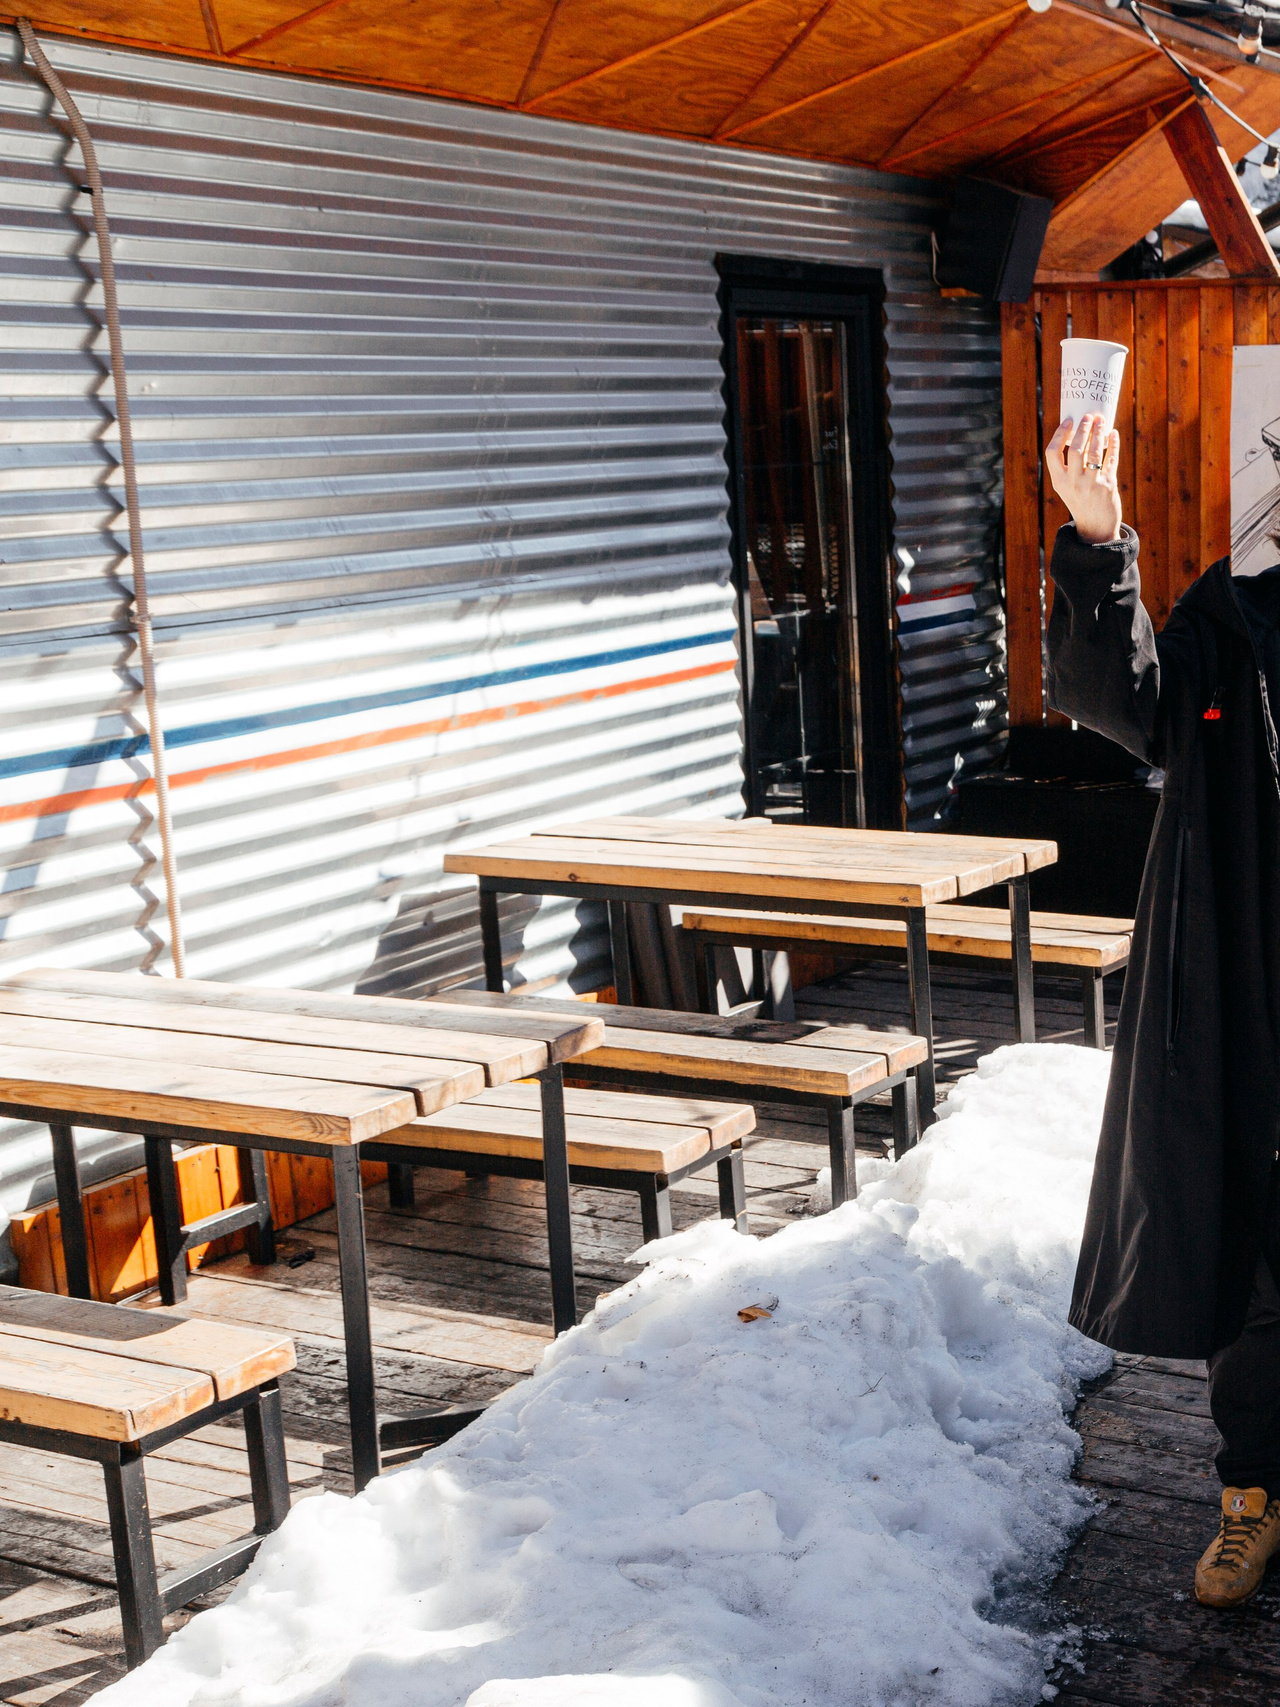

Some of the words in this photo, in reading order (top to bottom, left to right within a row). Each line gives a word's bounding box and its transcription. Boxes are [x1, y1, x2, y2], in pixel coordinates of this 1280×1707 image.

[1066, 367, 1087, 376] EASY
[1070, 378, 1115, 394] COFFEE
[1065, 390, 1085, 399] EASY
